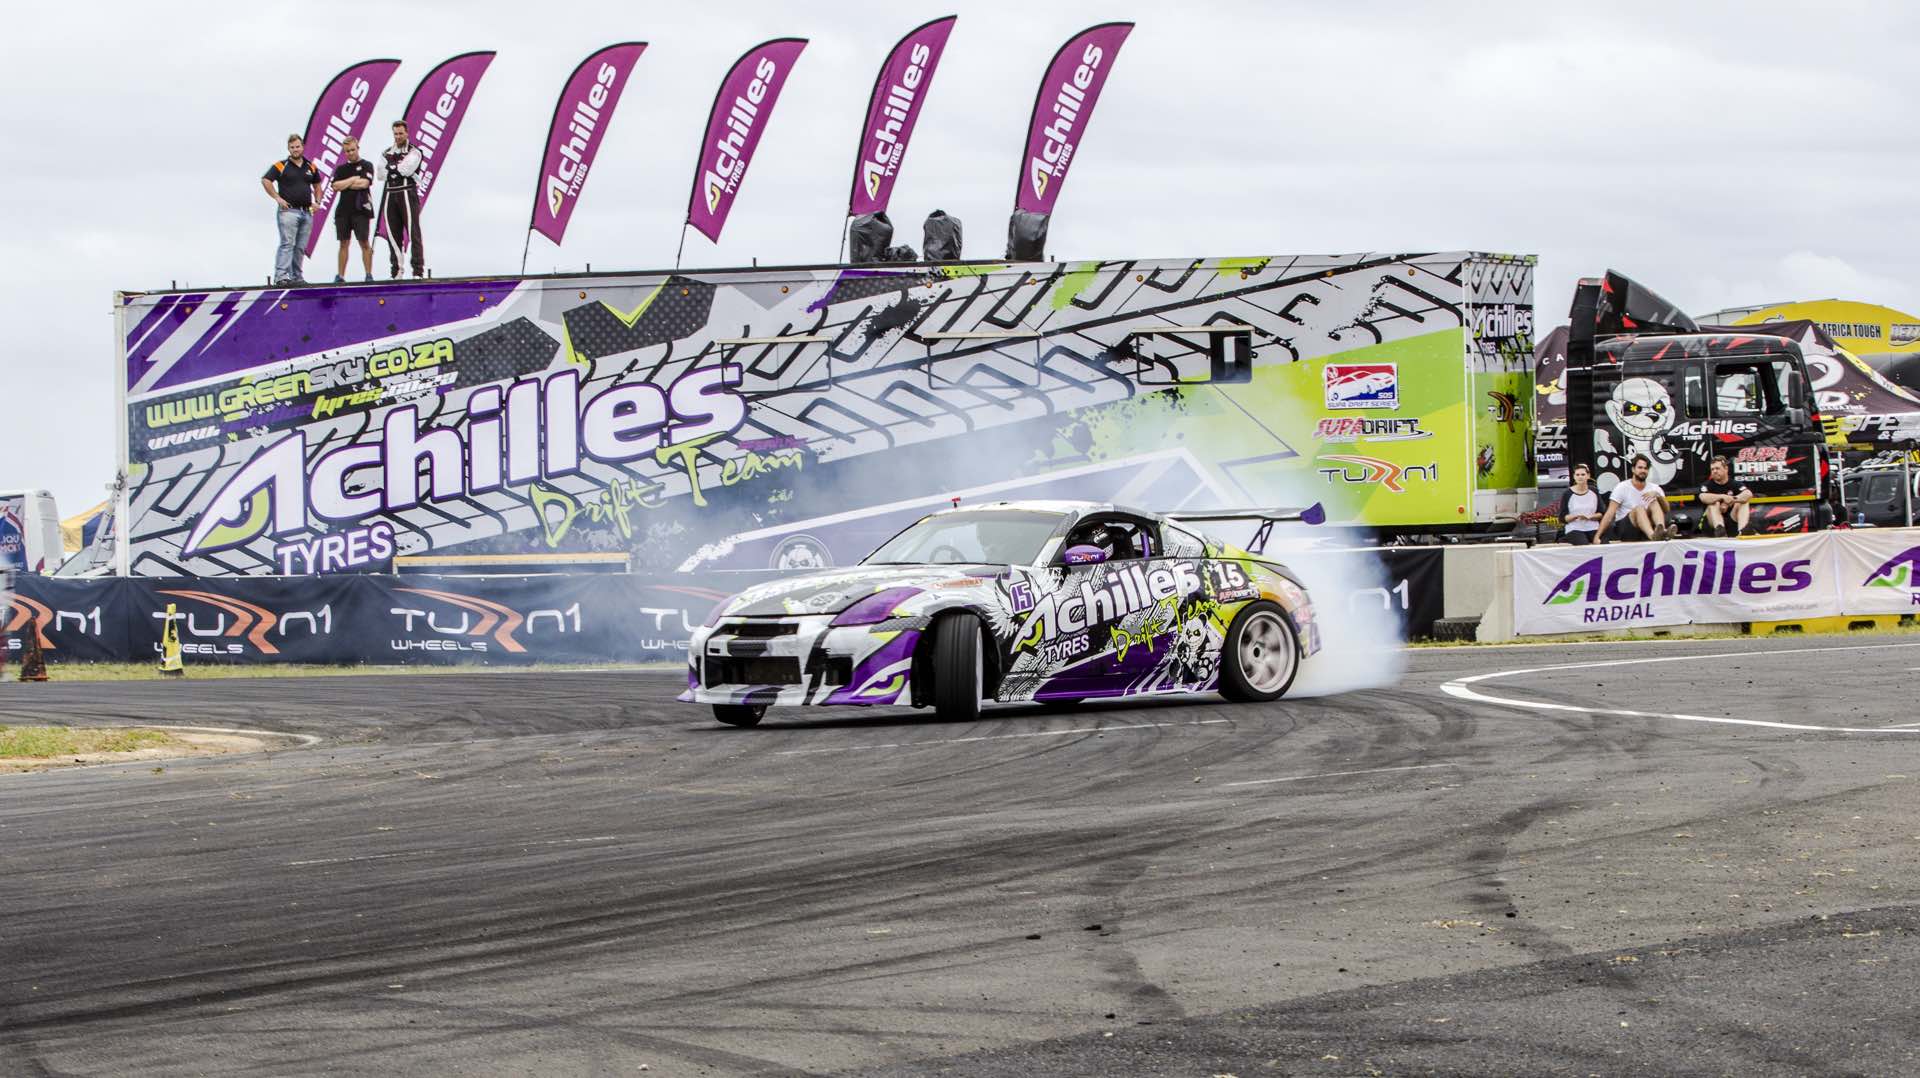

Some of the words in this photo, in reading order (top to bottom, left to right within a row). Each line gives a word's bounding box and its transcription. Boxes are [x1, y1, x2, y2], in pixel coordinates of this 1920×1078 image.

[704, 57, 776, 215] Achilles
[863, 43, 930, 200] Achilles
[1031, 43, 1103, 200] Achilles
[547, 62, 617, 218] Achilles
[724, 160, 746, 194] TYRES
[885, 143, 904, 177] TYRES
[1052, 143, 1073, 178] TYRES
[416, 170, 434, 198] YRES
[567, 163, 588, 197] TYRES
[1473, 305, 1532, 338] Achilles
[1854, 324, 1881, 338] TOUGH
[1348, 400, 1369, 408] DRIFT
[1668, 420, 1757, 436] Achilles
[184, 362, 750, 558] Achilles
[1734, 461, 1788, 473] DRIFT
[529, 478, 668, 547] Drift
[656, 430, 803, 507] Team
[277, 525, 392, 576] TYRES
[1215, 563, 1245, 589] 15
[1542, 550, 1812, 605] Achilles
[1009, 581, 1035, 614] 15
[1010, 562, 1201, 655] Achilles
[1583, 602, 1655, 623] RADIAL
[391, 640, 488, 652] WHEELS
[1045, 635, 1090, 663] TYRES
[1110, 618, 1168, 662] Drift
